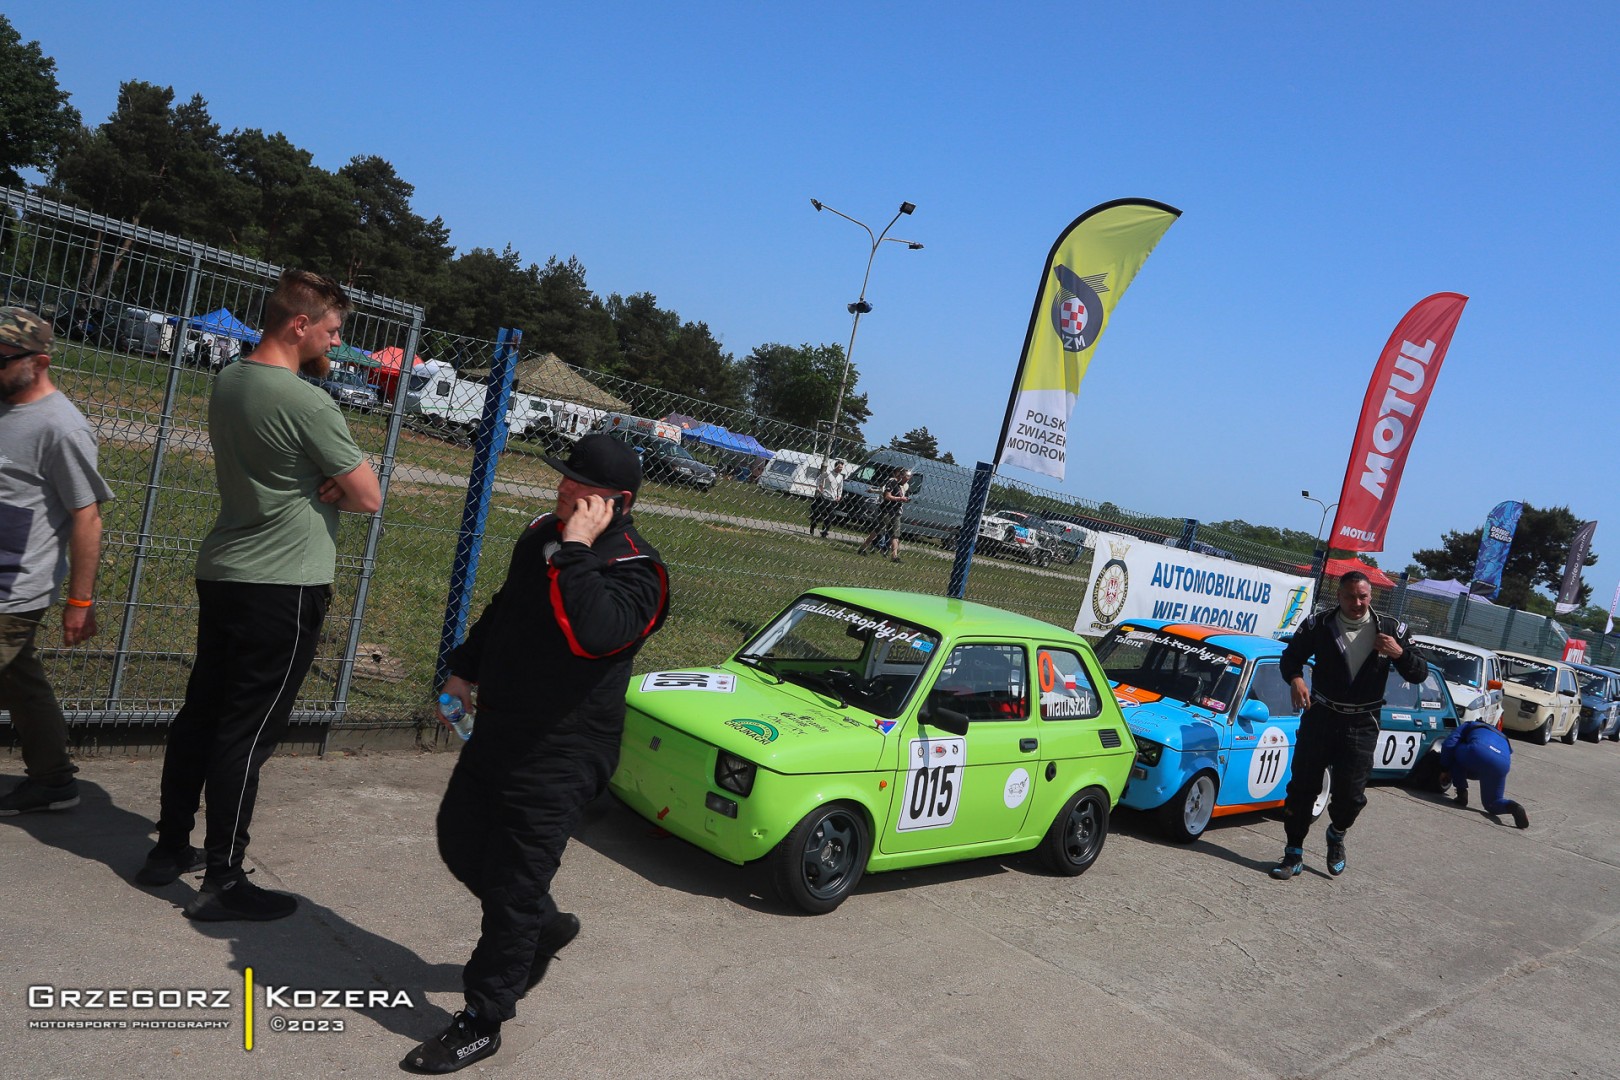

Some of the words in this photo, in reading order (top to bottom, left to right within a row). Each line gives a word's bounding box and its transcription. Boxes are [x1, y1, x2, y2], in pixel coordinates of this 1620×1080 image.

[1026, 409, 1067, 432] POLSK
[1360, 338, 1436, 501] MOTUL
[1007, 437, 1067, 463] MOTOROW
[1339, 525, 1376, 543] MOTUL
[1150, 561, 1272, 605] AUTOMOBILKLUB
[796, 602, 921, 643] maluch-trophy.pl
[1152, 600, 1259, 634] WIELKOPOLSKI
[1114, 635, 1144, 648] Talent
[653, 673, 710, 688] 015
[1046, 691, 1091, 717] Matuszak
[724, 720, 771, 745] CHOJNACKI
[1256, 749, 1281, 784] 111
[909, 765, 956, 820] 015
[456, 1036, 491, 1058] sparco
